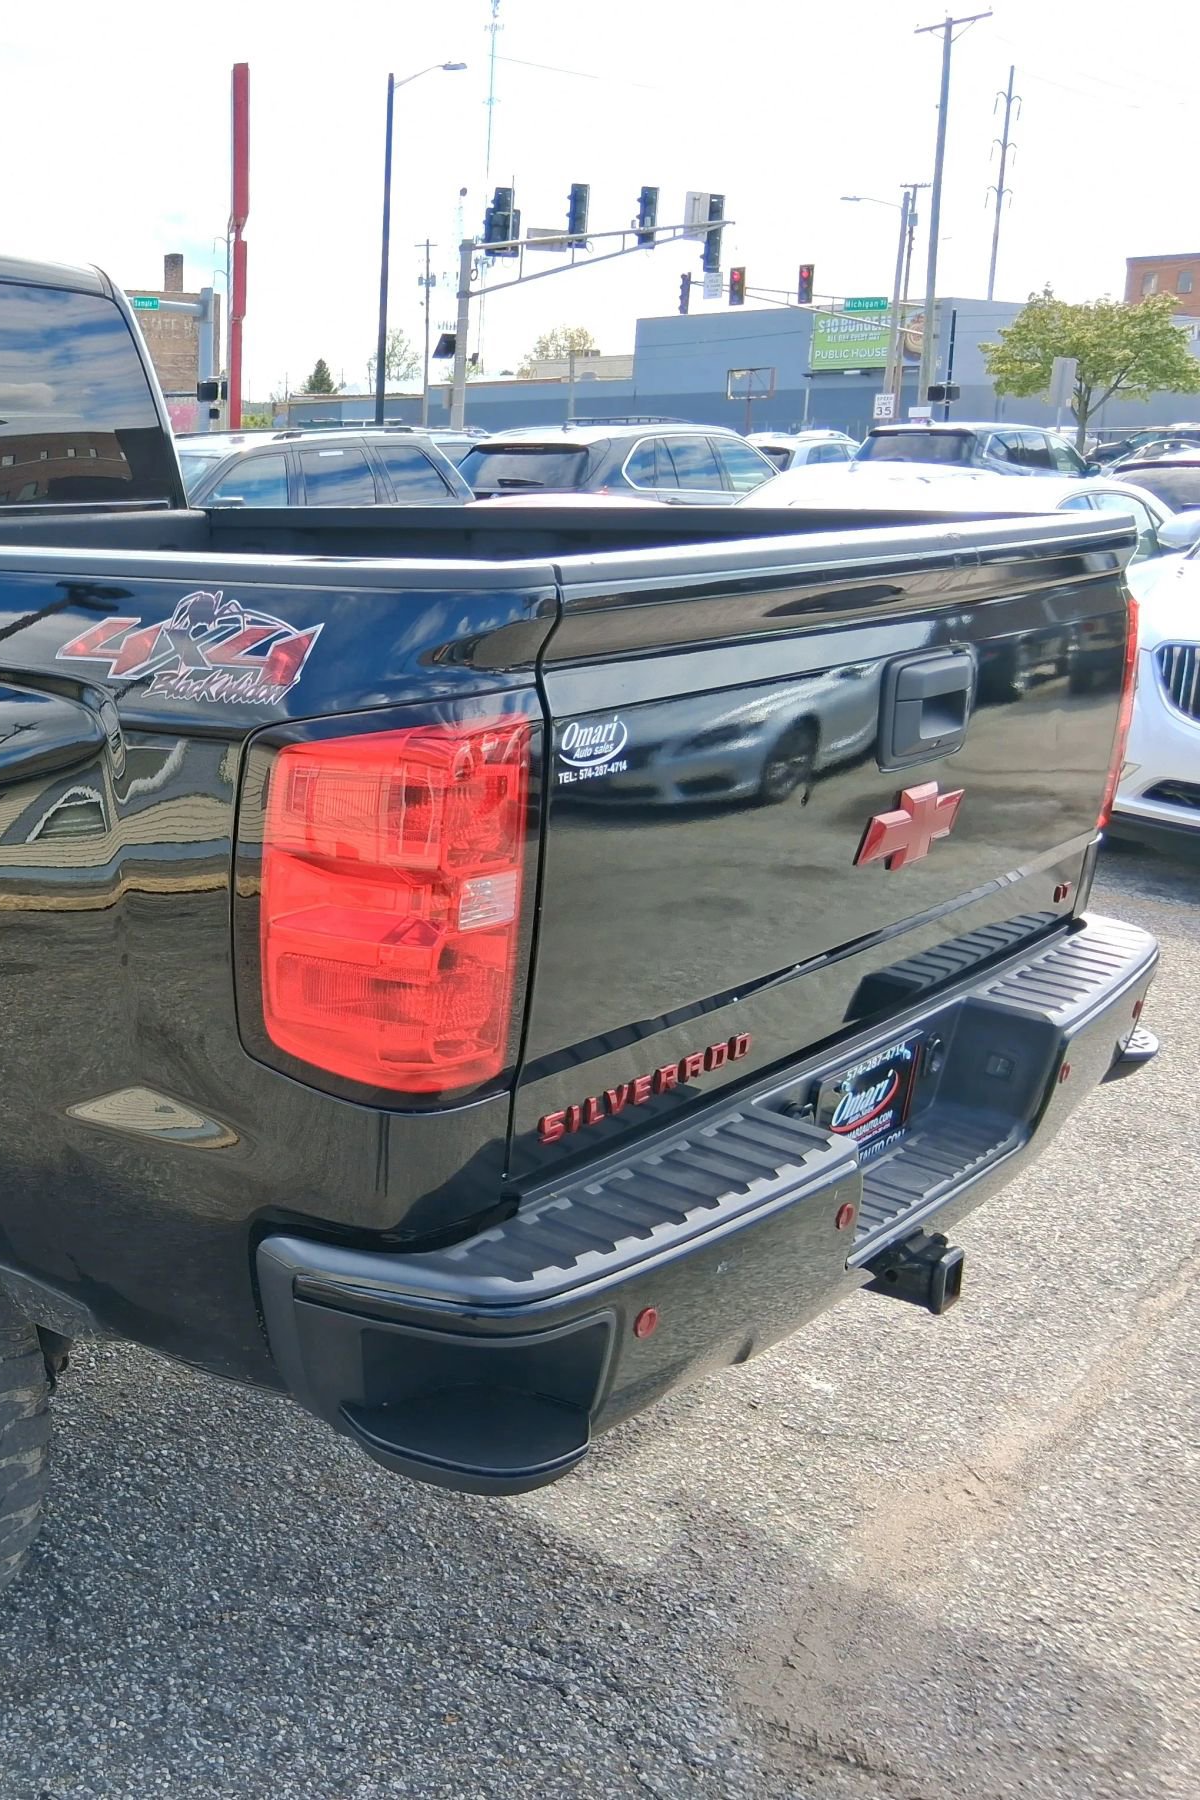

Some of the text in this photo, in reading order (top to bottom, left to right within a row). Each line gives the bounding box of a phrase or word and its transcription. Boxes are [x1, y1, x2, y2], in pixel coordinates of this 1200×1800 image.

[845, 300, 879, 309] Michigan
[818, 318, 839, 334] $10
[815, 347, 888, 359] PUBLIC HOUSE
[876, 406, 892, 416] 35
[561, 715, 619, 751] Omari
[572, 748, 593, 760] Auto
[558, 771, 578, 784] TEL:
[537, 1031, 752, 1145] SILVERADO
[831, 1068, 895, 1127] Omari
